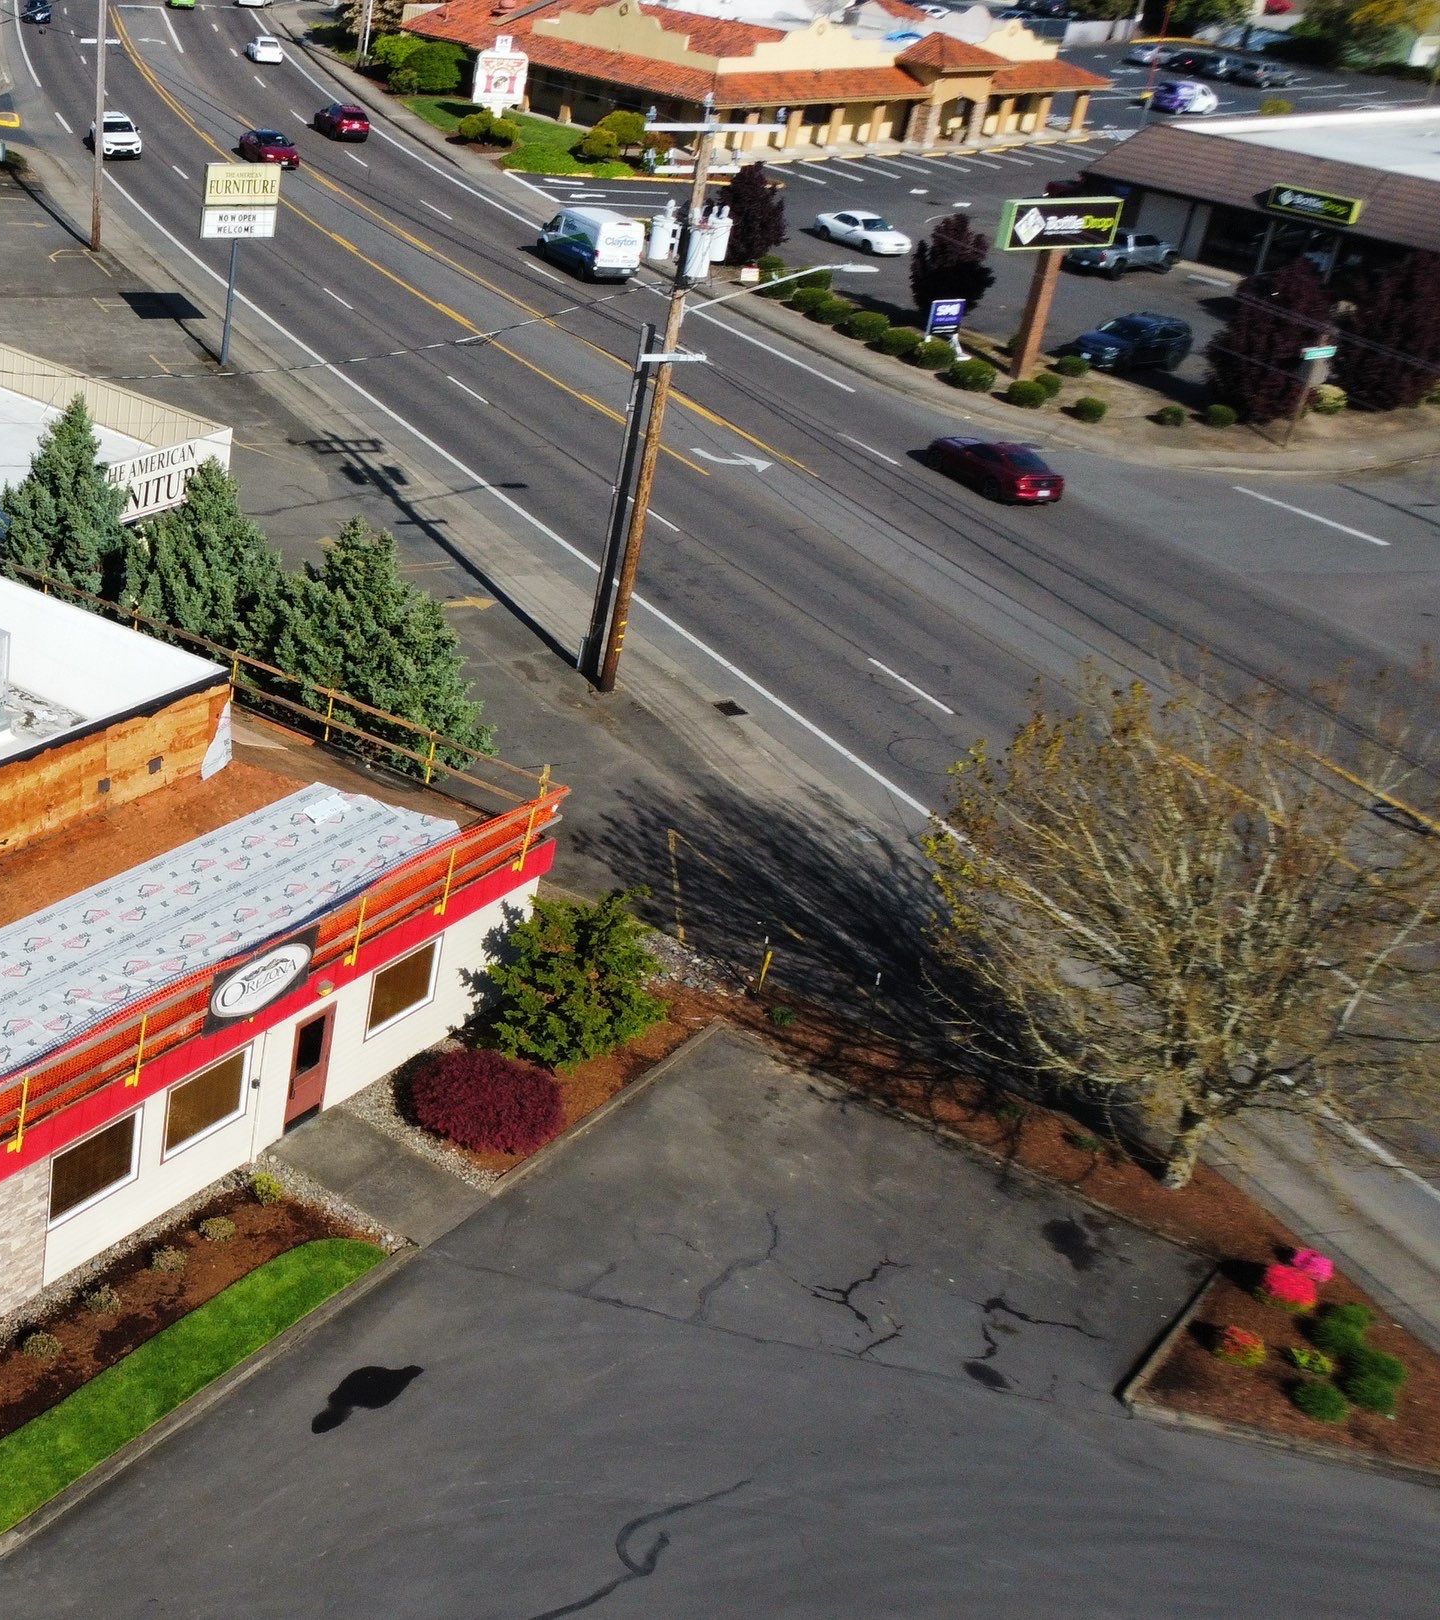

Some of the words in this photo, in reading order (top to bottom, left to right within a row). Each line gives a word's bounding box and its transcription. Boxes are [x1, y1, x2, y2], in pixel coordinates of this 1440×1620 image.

[209, 179, 277, 194] FURNITURE
[218, 214, 236, 222] NOW
[238, 214, 257, 222] OPEN
[217, 226, 255, 234] WELCOME
[605, 236, 637, 248] Clayton
[108, 464, 126, 484] HE
[128, 442, 197, 478] AMERICAN
[220, 959, 298, 1007] OREZONA
